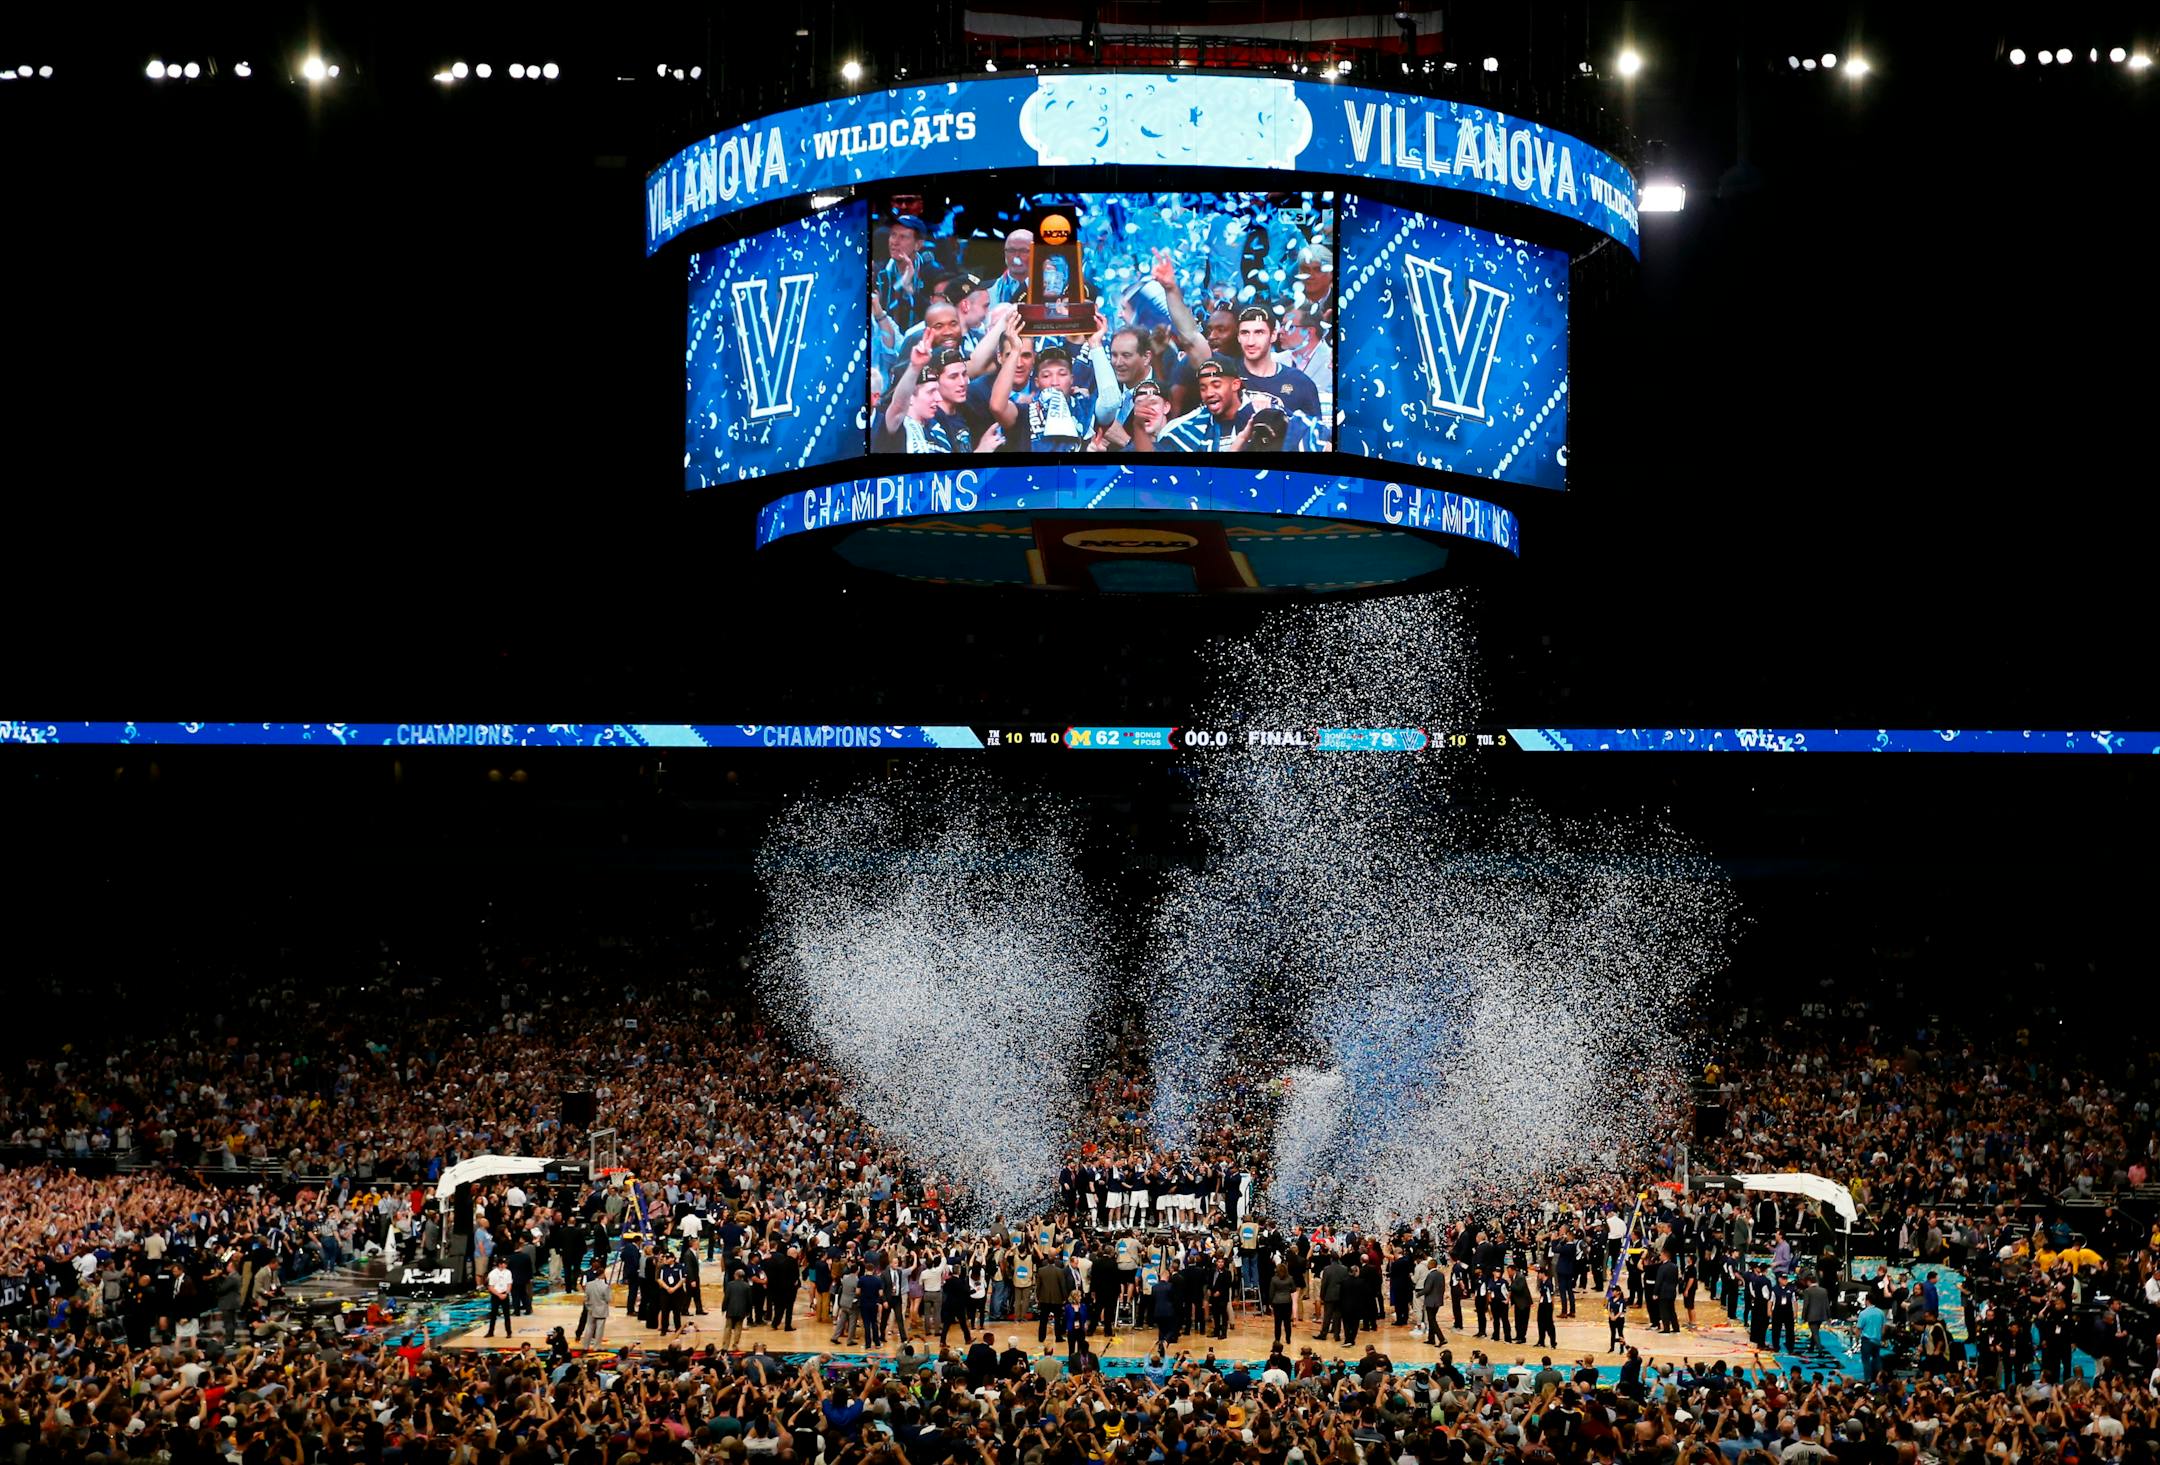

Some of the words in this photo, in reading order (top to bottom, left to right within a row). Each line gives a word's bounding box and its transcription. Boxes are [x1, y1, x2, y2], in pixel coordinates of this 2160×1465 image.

[1344, 100, 1577, 205] VILLANOVA
[648, 127, 788, 241] VILLANOVA
[813, 112, 976, 160] WILDCATS
[396, 724, 514, 745] CHAMPIONS
[763, 726, 882, 747] CHAMPIONS
[988, 730, 1000, 738] TM
[1005, 732, 1023, 744] 10
[1029, 732, 1047, 744] TOL
[1050, 732, 1060, 744] 0
[1070, 730, 1091, 746] M
[1095, 730, 1120, 745] 62
[1135, 731, 1161, 739] BONUS
[1185, 731, 1228, 746] 00.0
[1248, 731, 1308, 746] FINAL
[1369, 732, 1393, 747] 79
[1449, 735, 1467, 746] 10
[1477, 735, 1494, 745] TOL
[1497, 735, 1507, 746] 3
